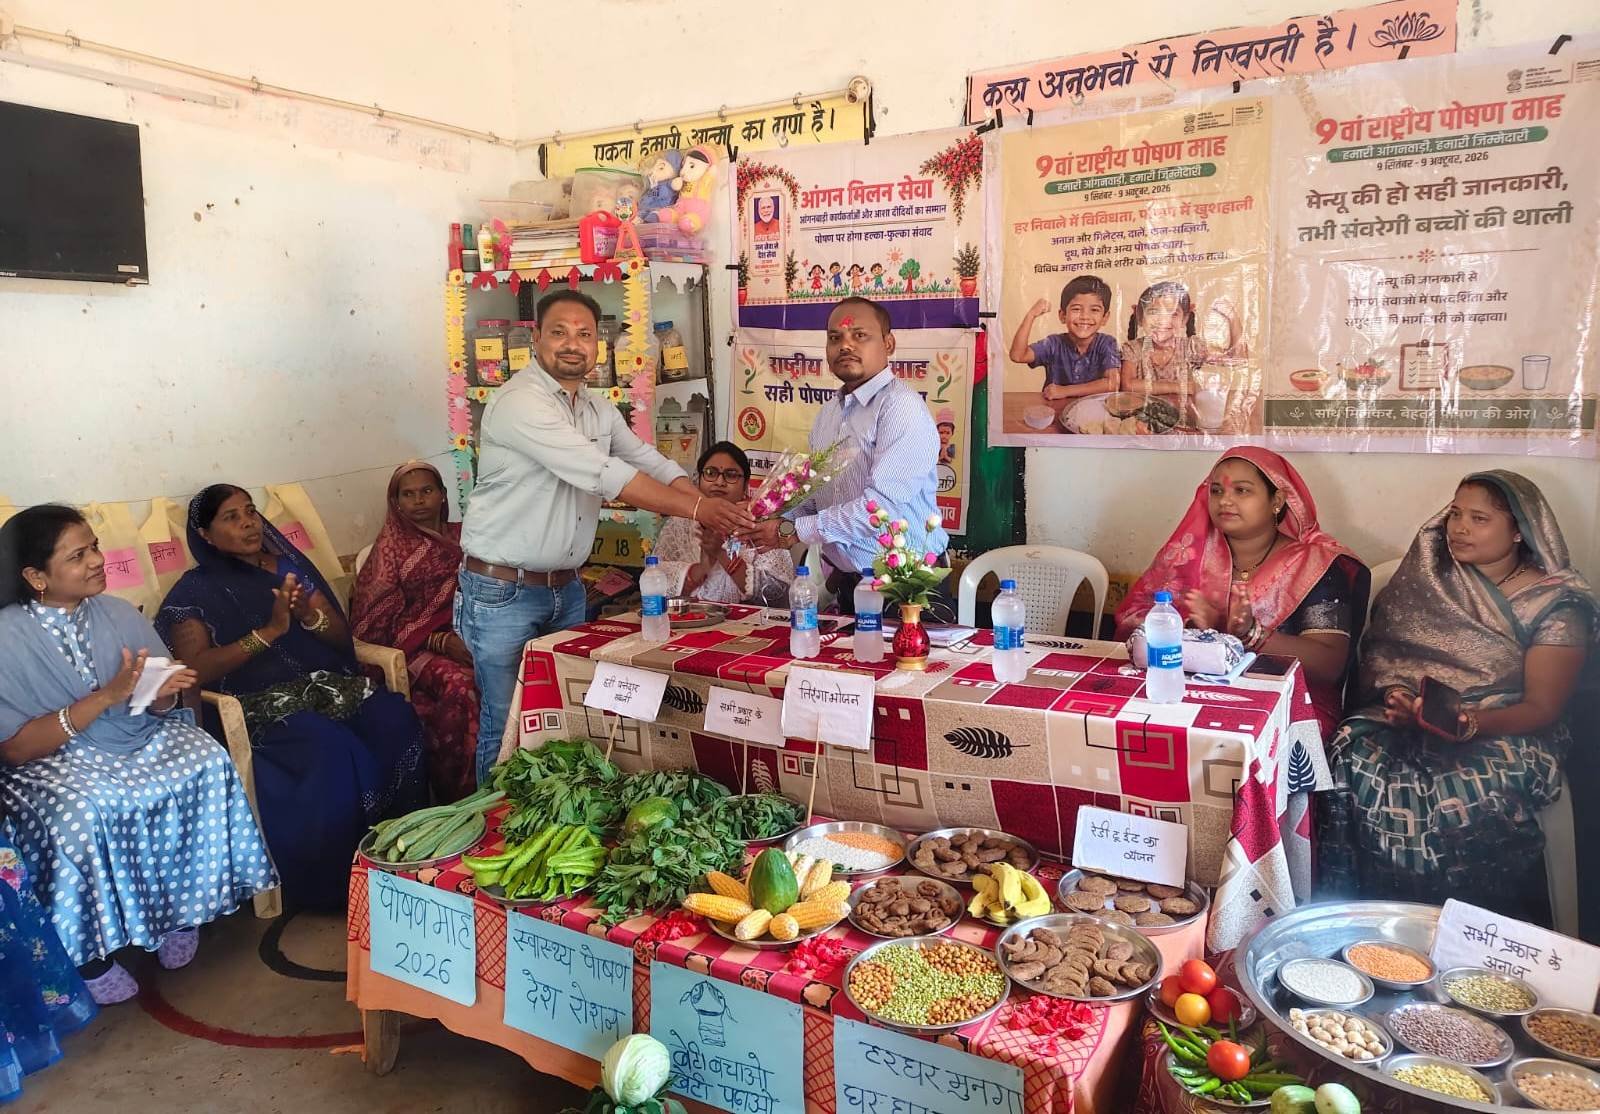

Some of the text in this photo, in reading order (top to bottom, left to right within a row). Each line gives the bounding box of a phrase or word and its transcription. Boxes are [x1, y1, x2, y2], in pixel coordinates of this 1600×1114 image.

[982, 77, 1028, 113] कला
[1039, 52, 1140, 104] अनुभवों
[1193, 23, 1304, 80] निखरती
[1315, 94, 1566, 145] 9वां राष्ट्रीय पोषण माह
[593, 140, 634, 167] एकता
[741, 119, 765, 143] का
[772, 112, 805, 148] गुण
[1343, 145, 1374, 161] हमारी
[1435, 134, 1470, 151] हमारी
[1472, 128, 1530, 147] जिम्मेदारी
[1036, 136, 1228, 178] 9वां राष्ट्रीय पोषण माह
[1464, 151, 1489, 162] 2026
[801, 174, 935, 209] आंगन मिलन सेवा
[1056, 177, 1082, 192] हमारी
[1128, 169, 1156, 184] हमारी
[1157, 165, 1202, 182] जिम्मेदारी
[1151, 184, 1172, 195] 2026
[1306, 165, 1569, 215] मेन्यू की हो सही जानकारी,
[861, 208, 873, 219] और
[874, 207, 890, 218] आशा
[914, 205, 924, 216] का
[925, 203, 947, 215] सम्मान
[1014, 195, 1255, 234] हर निवाले में विविधता, पण में खुशहाली
[1298, 200, 1574, 242] तभी संवरेगी बच्चों की थाली
[814, 226, 934, 245] पोषण पर होगा हल्का-फुल्का संवाद
[1051, 236, 1075, 245] अनाज
[1077, 232, 1092, 242] और
[1081, 245, 1095, 257] मेवे
[1096, 243, 1112, 255] और
[1114, 243, 1132, 254] अन्य
[1034, 262, 1059, 274] विविध
[1060, 261, 1084, 272] आहार
[1085, 261, 1093, 270] से
[1094, 258, 1112, 270] मिले
[1113, 256, 1134, 268] शरीर
[1485, 288, 1509, 302] और
[768, 352, 931, 380] राष्ट्रीय माह
[764, 380, 795, 404] सही
[1345, 406, 1397, 420] मिकर,
[1480, 405, 1504, 420] की
[614, 537, 630, 557] 18
[798, 679, 861, 707] तिरंगा भोजन
[1143, 836, 1160, 848] का
[375, 872, 472, 951] पोषण माह
[1462, 922, 1563, 971] सभी प्रकार के
[394, 942, 453, 985] 2026
[1482, 955, 1532, 980] अनाज
[522, 968, 627, 1042] देश रोशन
[708, 1051, 775, 1090] बचाओ
